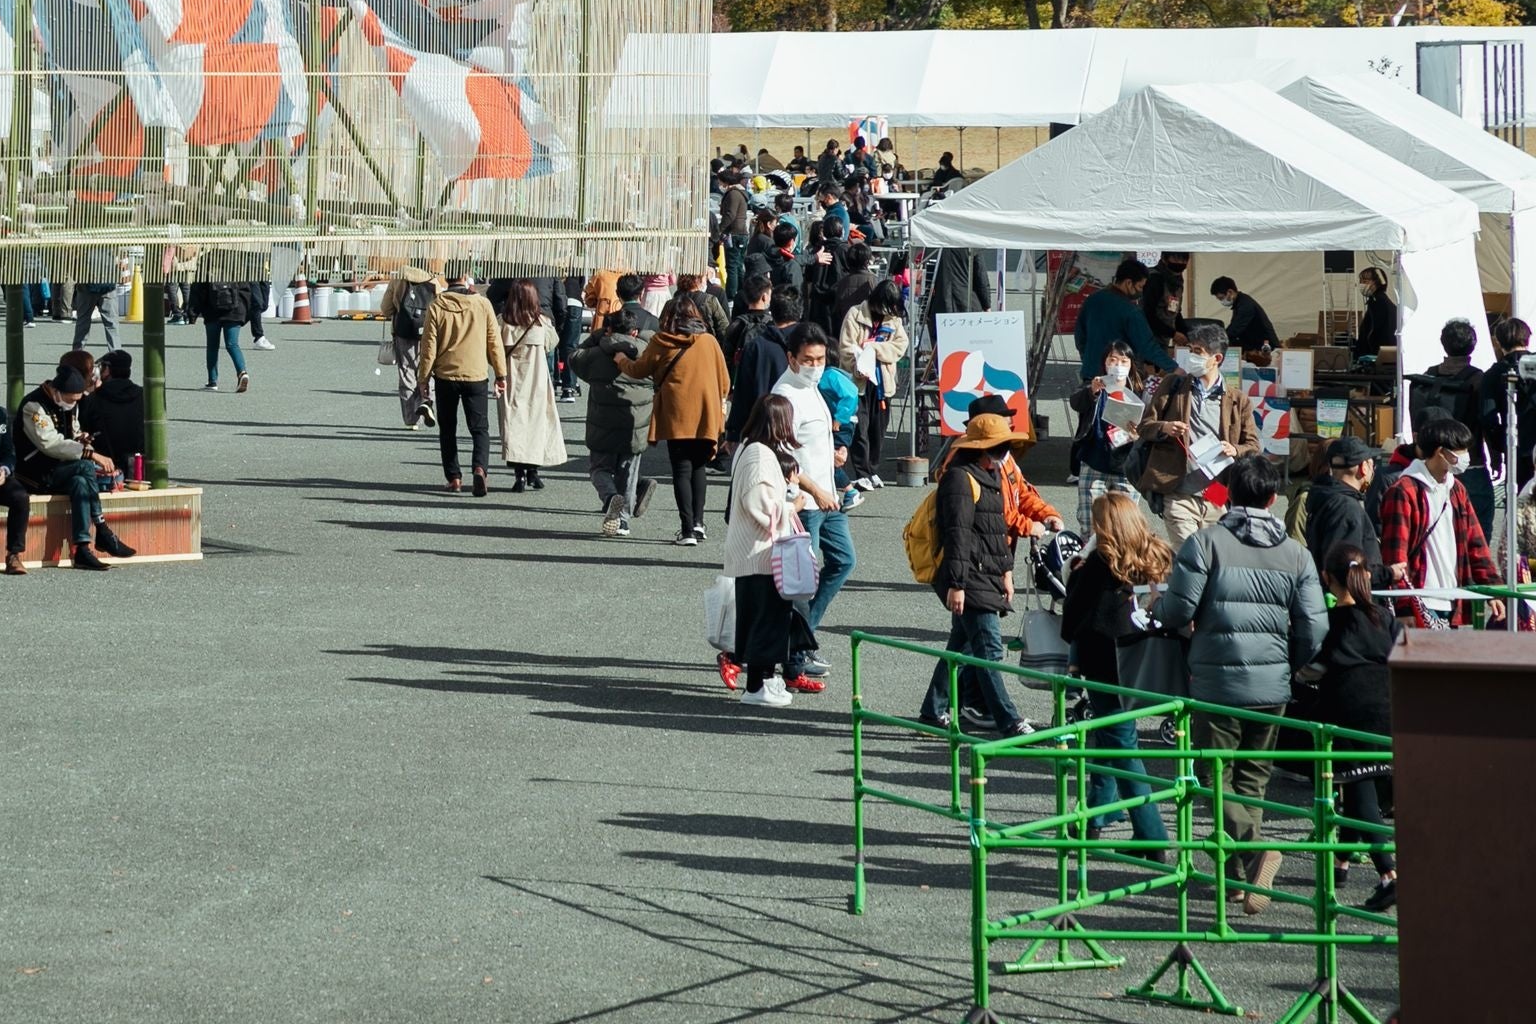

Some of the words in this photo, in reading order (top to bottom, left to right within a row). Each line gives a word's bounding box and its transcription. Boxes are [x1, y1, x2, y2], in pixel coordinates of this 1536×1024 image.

[941, 316, 1019, 327] インフォメーション
